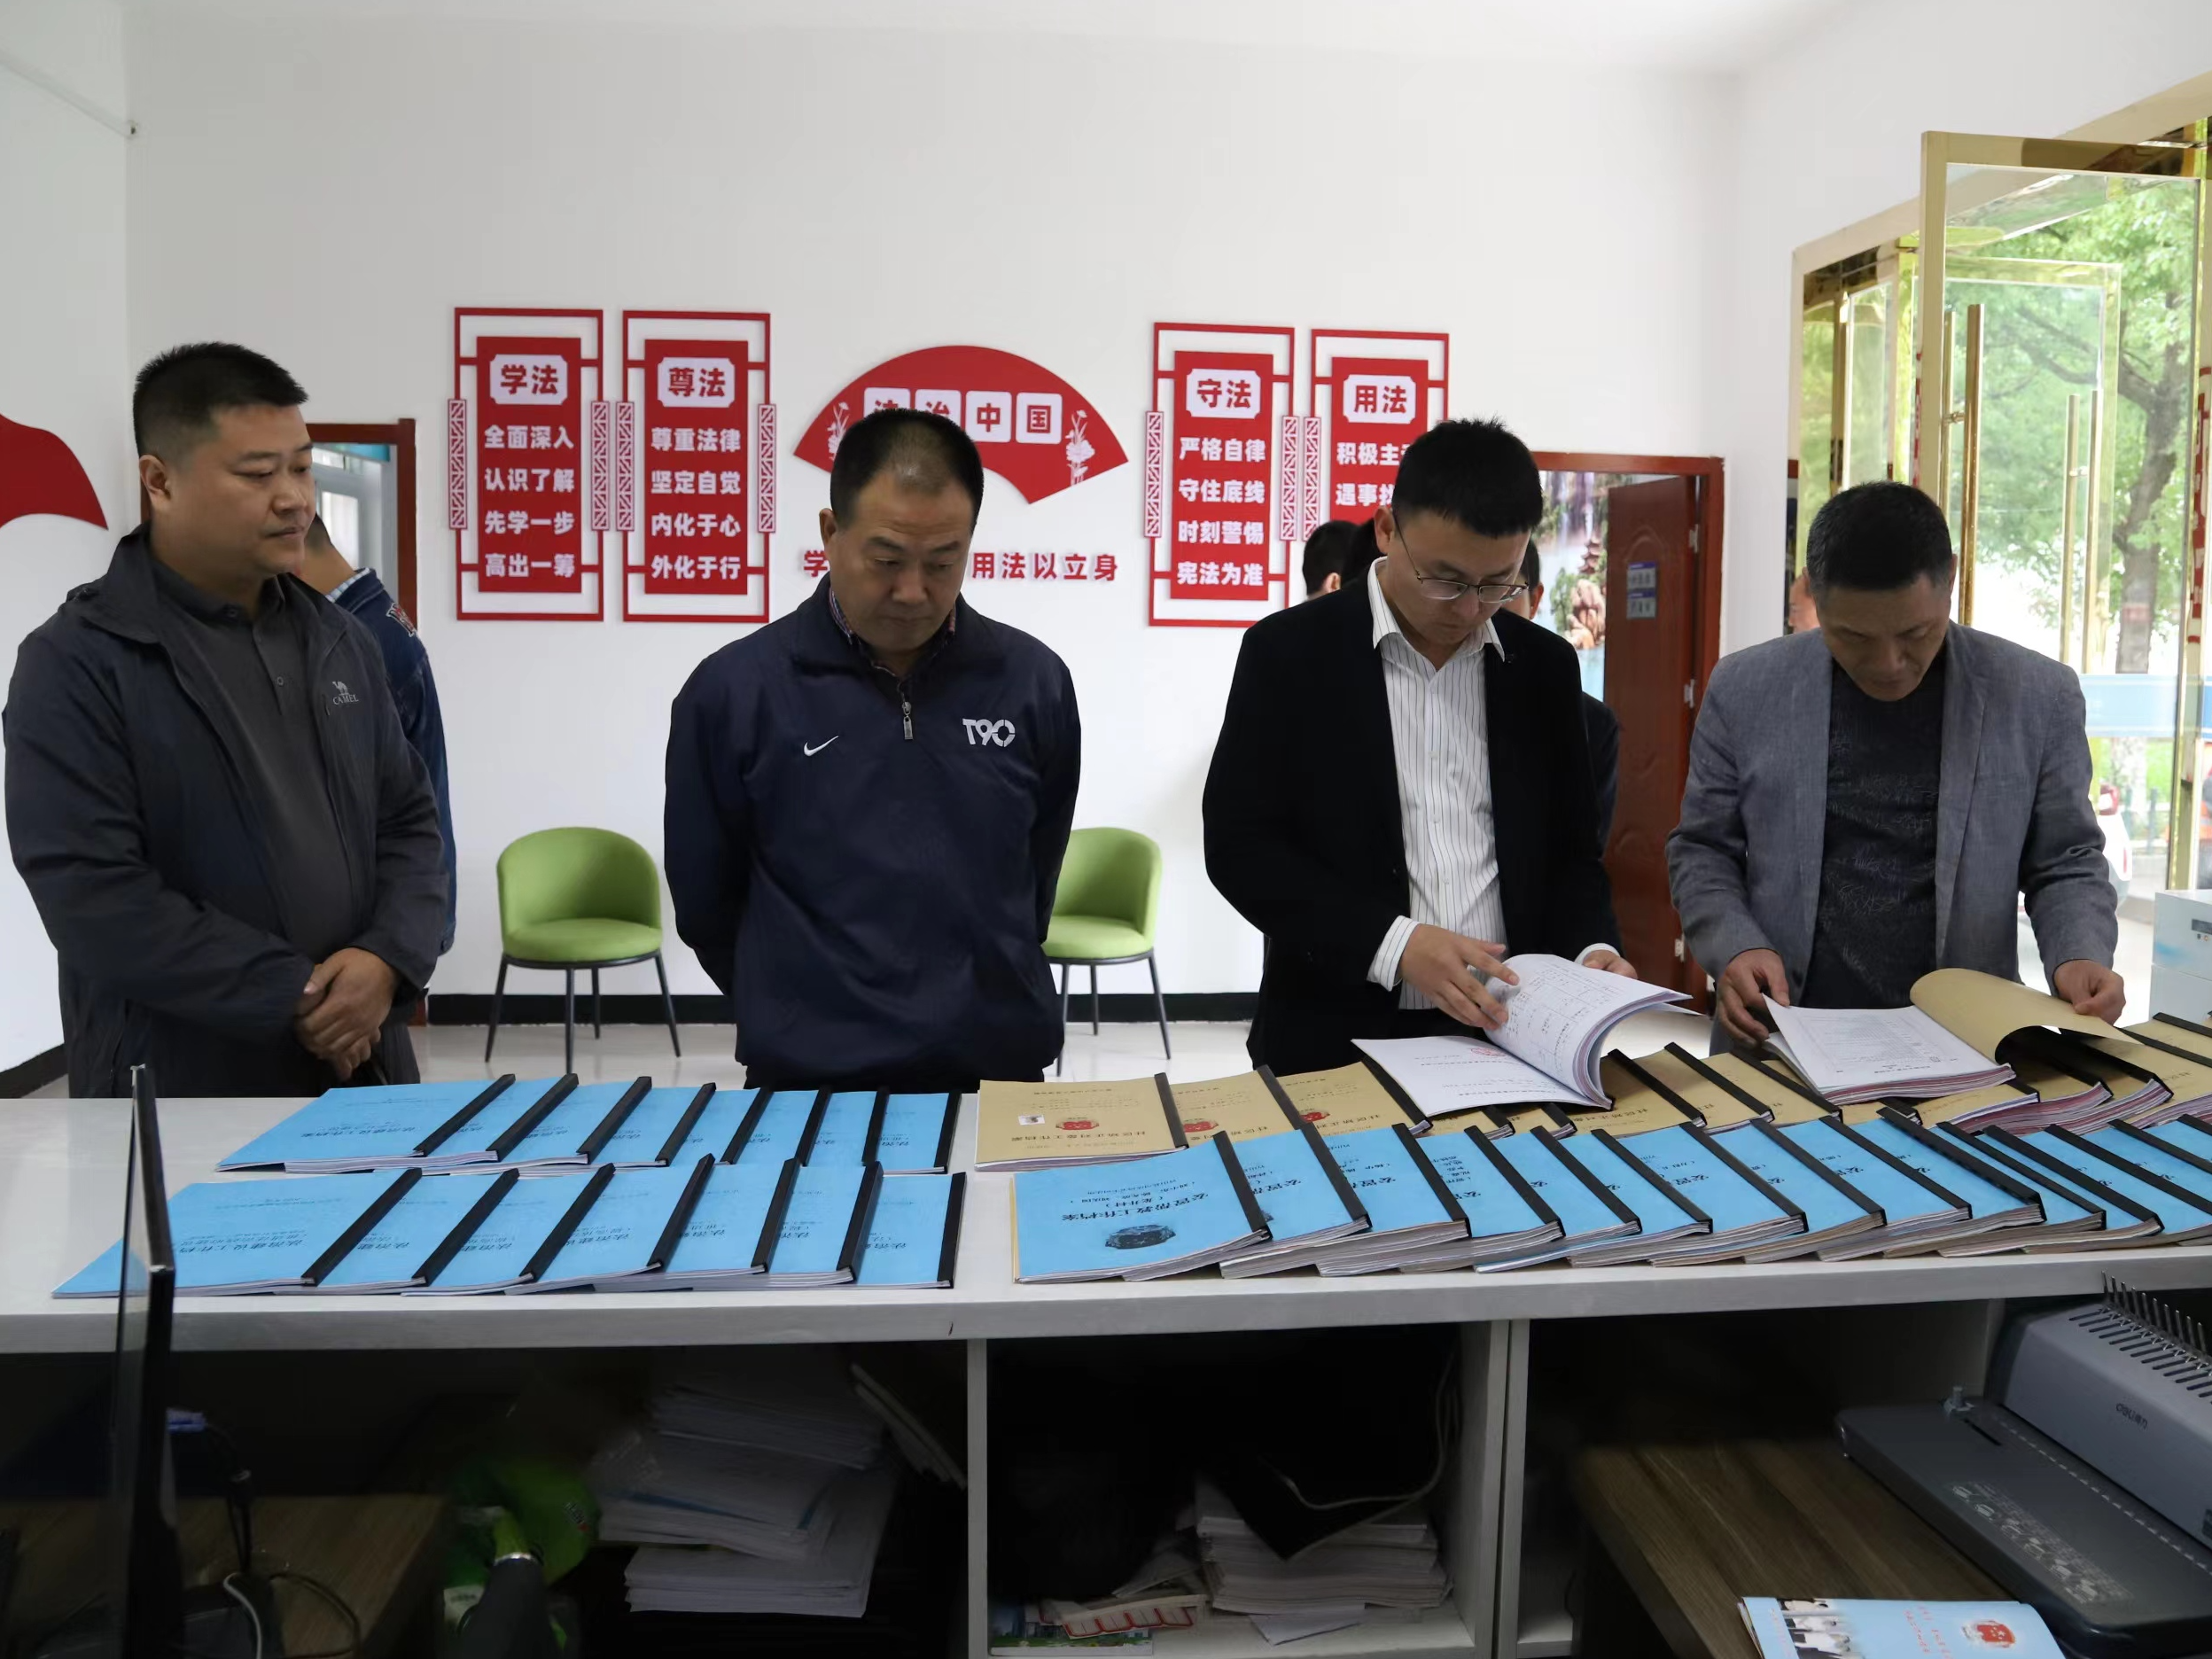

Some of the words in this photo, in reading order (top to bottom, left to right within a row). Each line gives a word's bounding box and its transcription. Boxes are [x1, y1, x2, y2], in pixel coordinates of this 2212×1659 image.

[501, 364, 559, 395] 学法
[669, 367, 726, 398] 尊法
[1197, 378, 1251, 409] 守法
[1354, 385, 1407, 414] 用法
[485, 424, 574, 449] 全面深入
[651, 427, 741, 452] 尊重法律
[1180, 437, 1266, 463] 严格自律
[1336, 442, 1411, 465] 积极主
[485, 468, 574, 493] 认识了解
[651, 471, 741, 495] 坚定自觉
[1179, 479, 1266, 503] 守住底线
[485, 510, 574, 534] 先学一步
[651, 513, 741, 536] 内化于心
[1178, 520, 1265, 545] 时刻警惕
[485, 553, 575, 578] 高出一筹
[651, 556, 741, 580] 外化于行
[972, 552, 1118, 581] 用法以立身
[1177, 561, 1264, 587] 宪法为准
[332, 694, 360, 705] CAMEL
[962, 718, 1016, 748] T90
